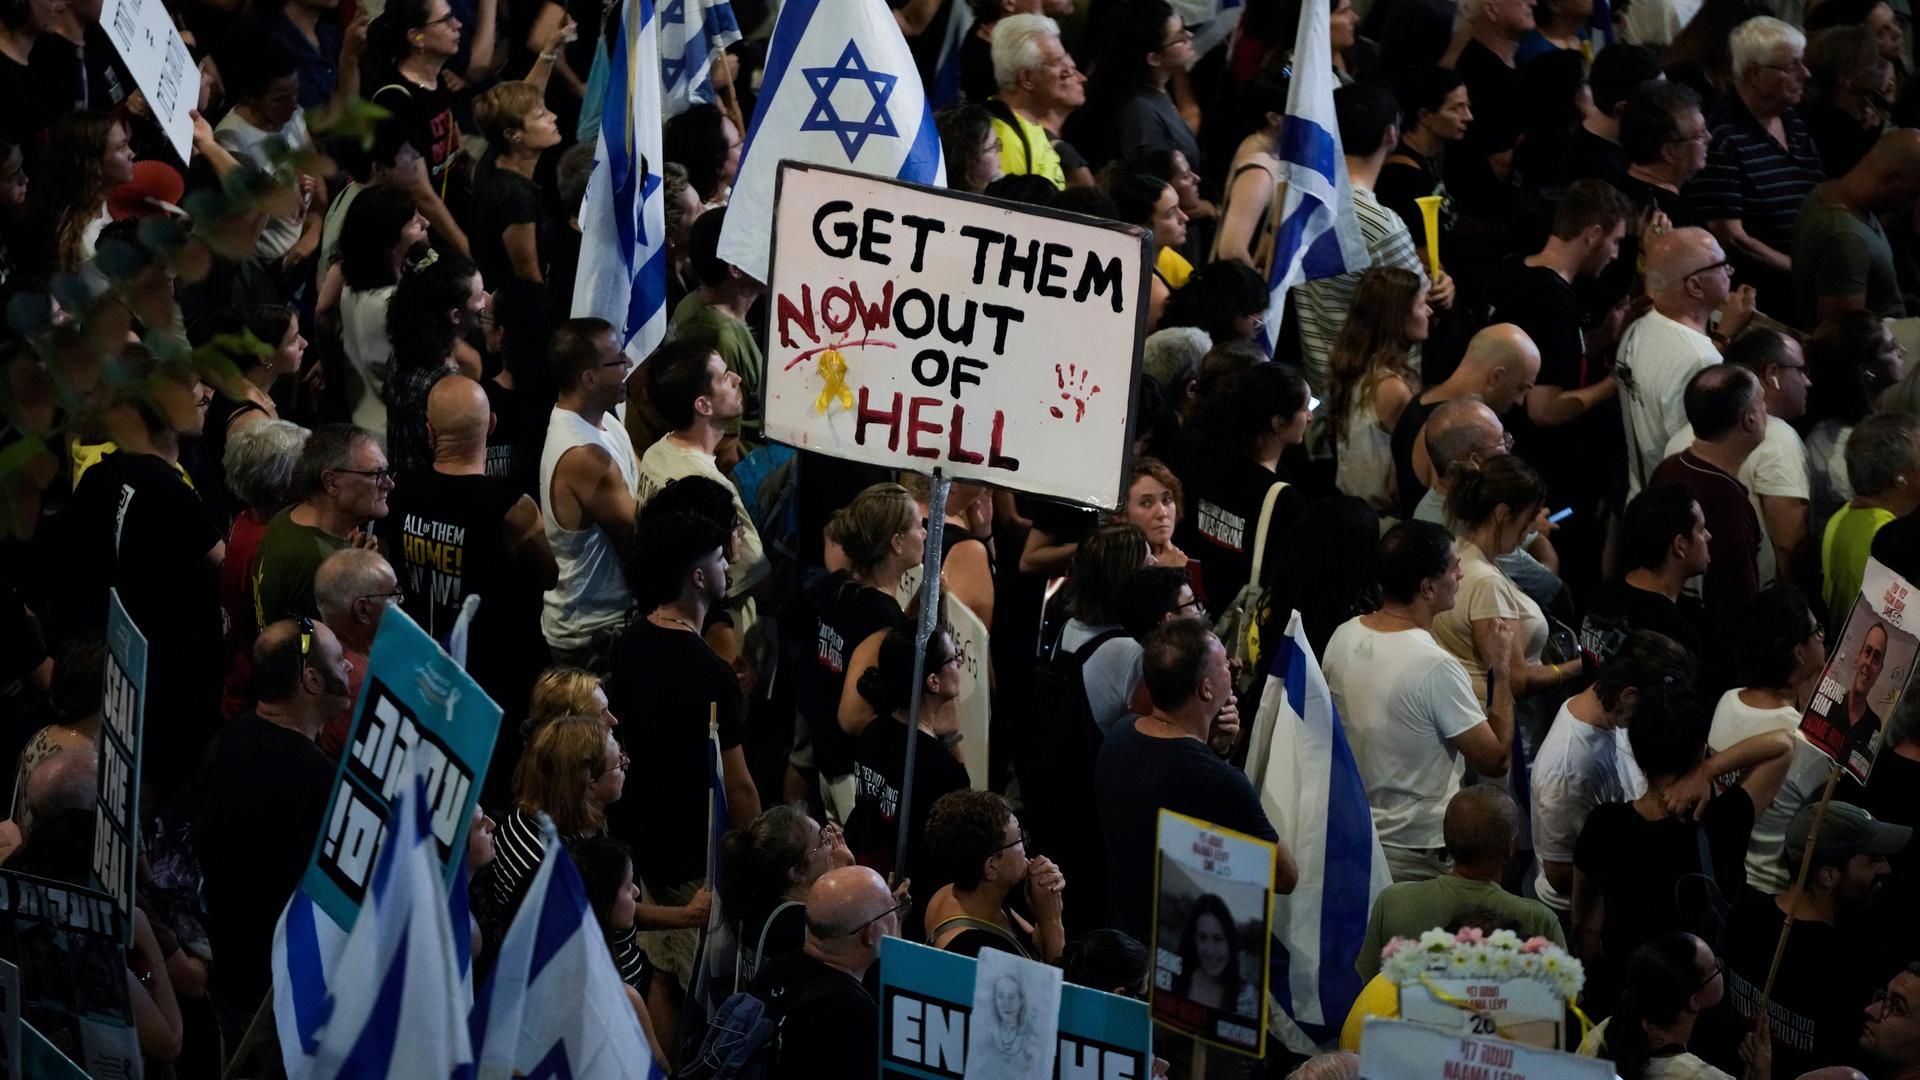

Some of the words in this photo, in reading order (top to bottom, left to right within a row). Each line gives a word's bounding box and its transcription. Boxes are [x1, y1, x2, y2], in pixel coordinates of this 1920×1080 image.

[813, 200, 945, 273] GET
[960, 225, 1124, 313] THEM
[777, 280, 894, 349] NOW
[892, 288, 1025, 355] OUT
[911, 348, 989, 399] OF
[854, 385, 1020, 471] HELL
[402, 533, 463, 576] HOME!
[403, 513, 424, 537] ALL
[423, 523, 432, 534] OF
[432, 520, 466, 546] THEM
[405, 561, 461, 610] NW!
[103, 649, 137, 757] SEAL
[1810, 692, 1834, 718] HIM
[1818, 676, 1848, 705] BRING
[103, 732, 129, 830] THE
[93, 802, 129, 915] DEAL
[891, 994, 966, 1075] EN
[1470, 1014, 1496, 1034] 20
